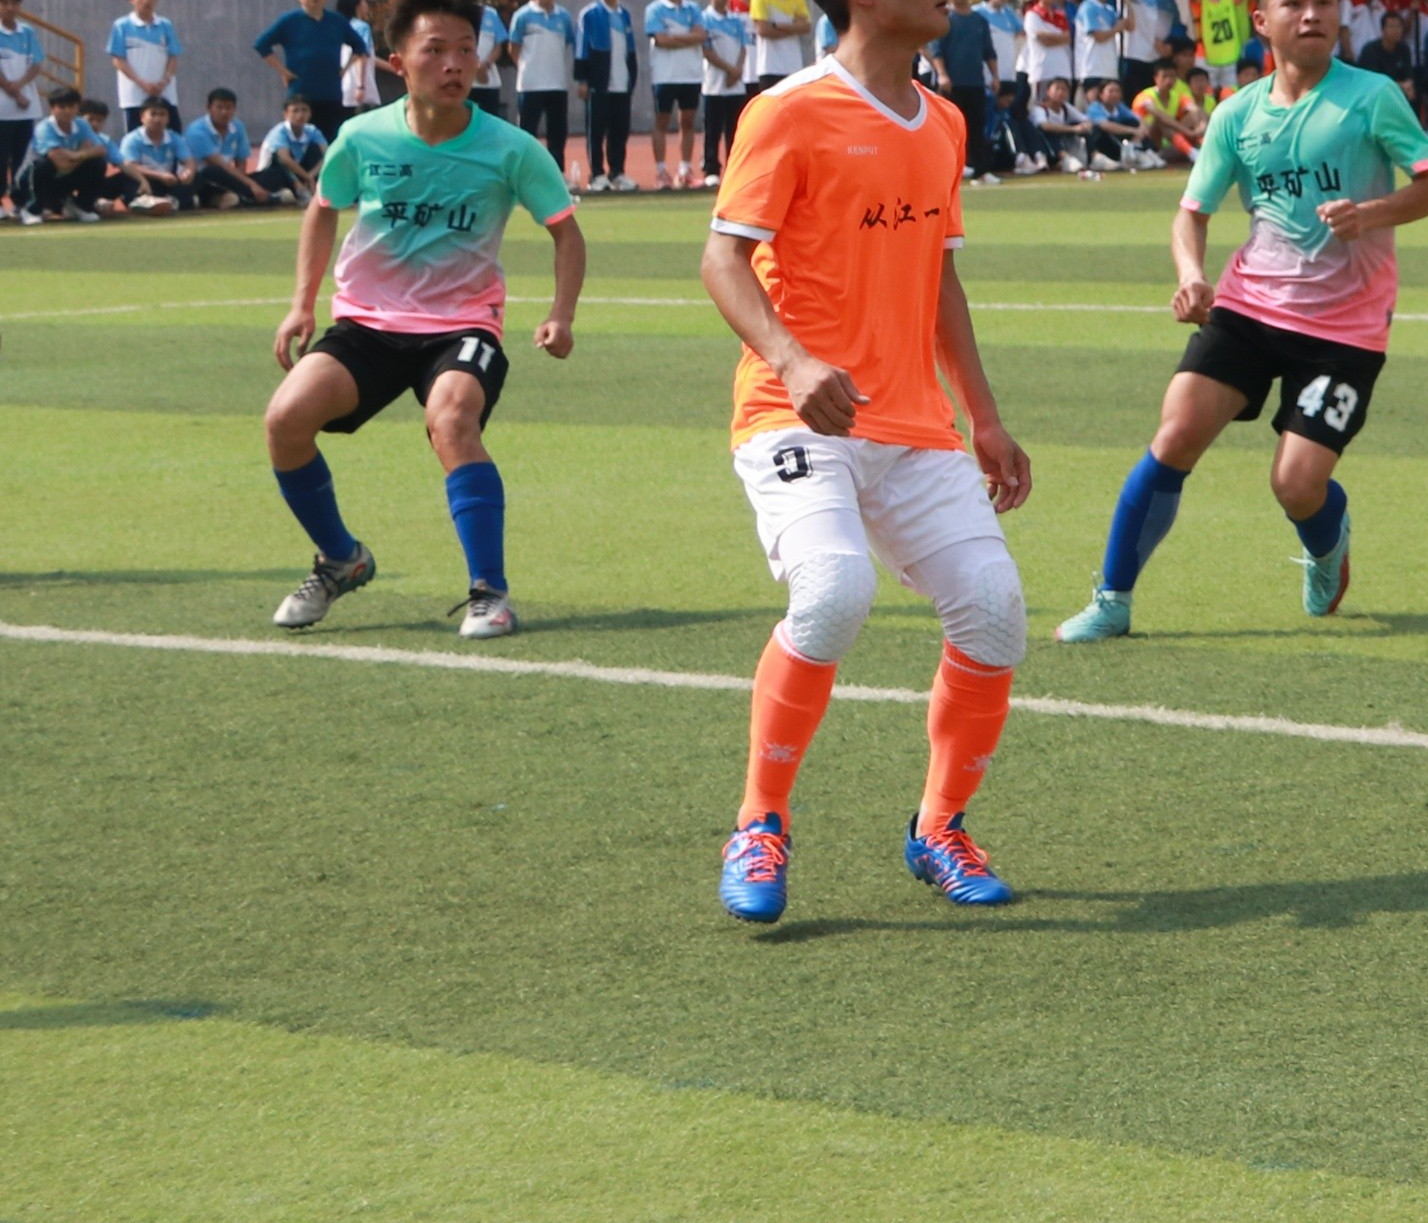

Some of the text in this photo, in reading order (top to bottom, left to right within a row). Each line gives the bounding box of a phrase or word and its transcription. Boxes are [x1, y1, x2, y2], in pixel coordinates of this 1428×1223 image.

[1211, 18, 1233, 44] 20
[1257, 162, 1341, 200] 平矿山
[382, 201, 477, 232] 平矿山
[859, 197, 940, 231] 从江一
[457, 336, 496, 374] 11
[1297, 375, 1359, 432] 43
